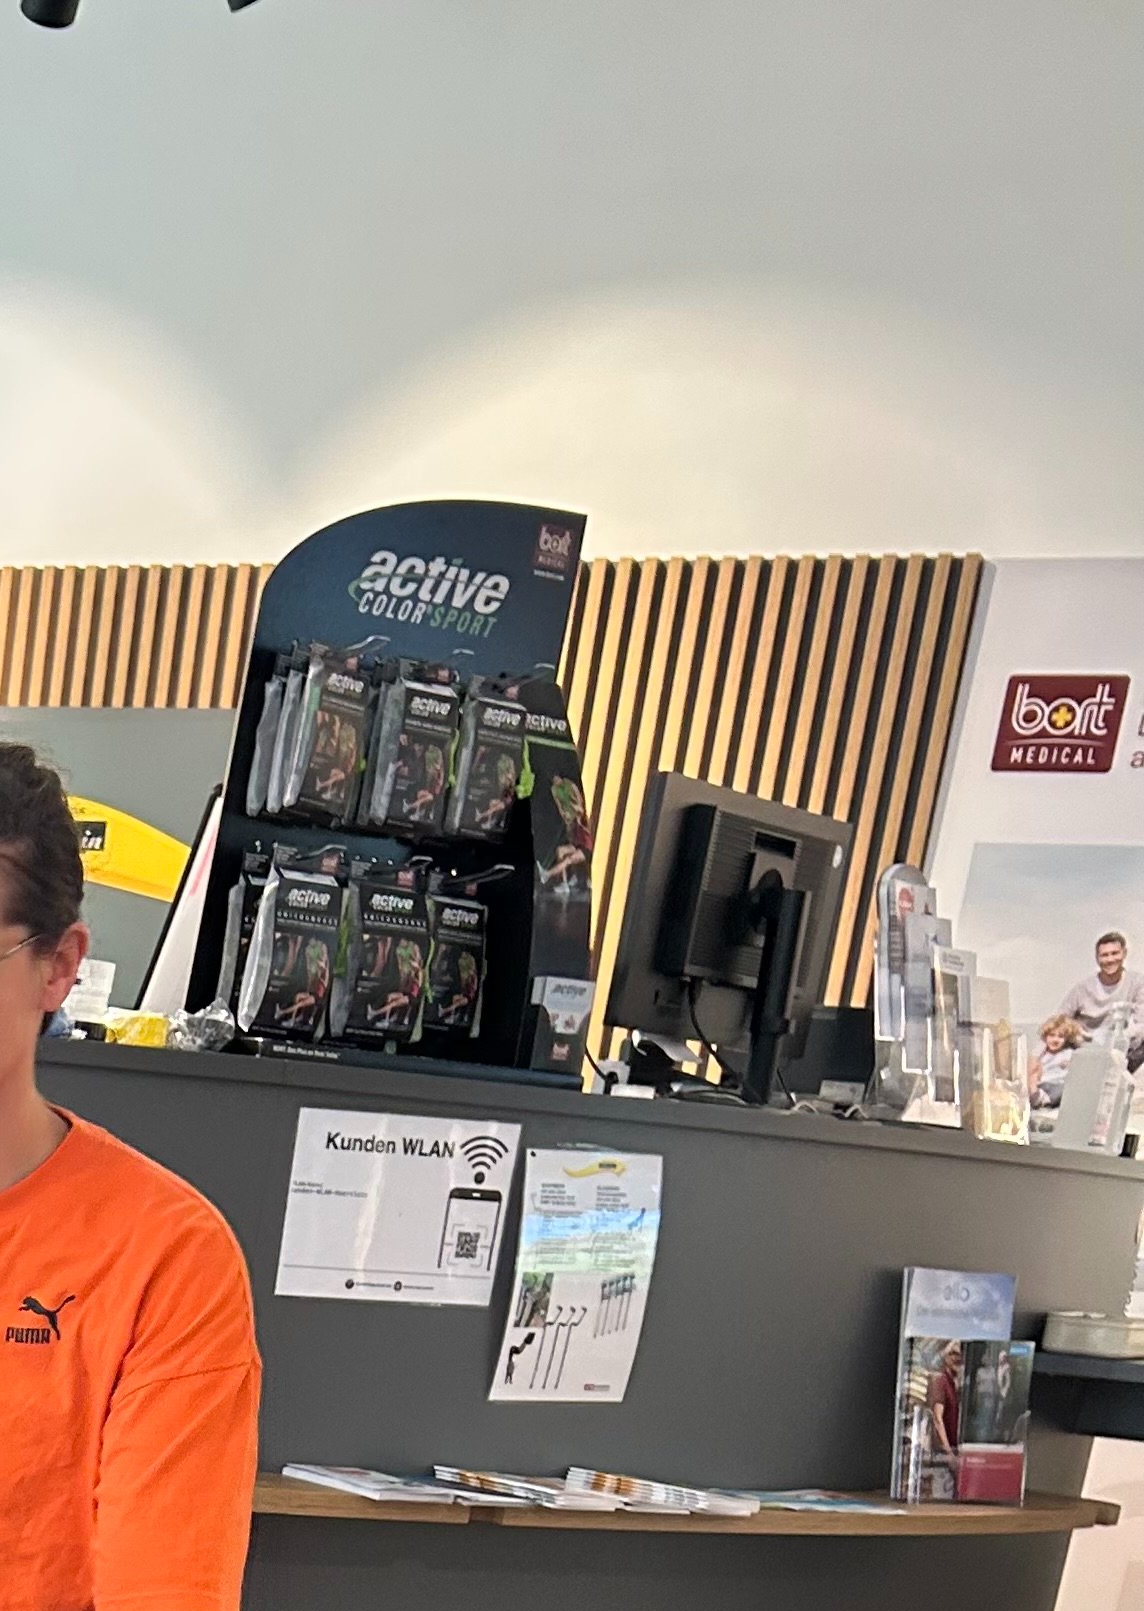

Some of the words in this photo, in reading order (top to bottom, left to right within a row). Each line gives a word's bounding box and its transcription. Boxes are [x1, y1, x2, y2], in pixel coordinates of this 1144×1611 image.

[359, 550, 510, 615] active
[1012, 683, 1115, 735] bort
[1010, 746, 1095, 764] MEDICAL
[325, 1131, 396, 1155] Kunden
[402, 1138, 456, 1158] WLAN
[6, 1327, 51, 1344] PUMA
